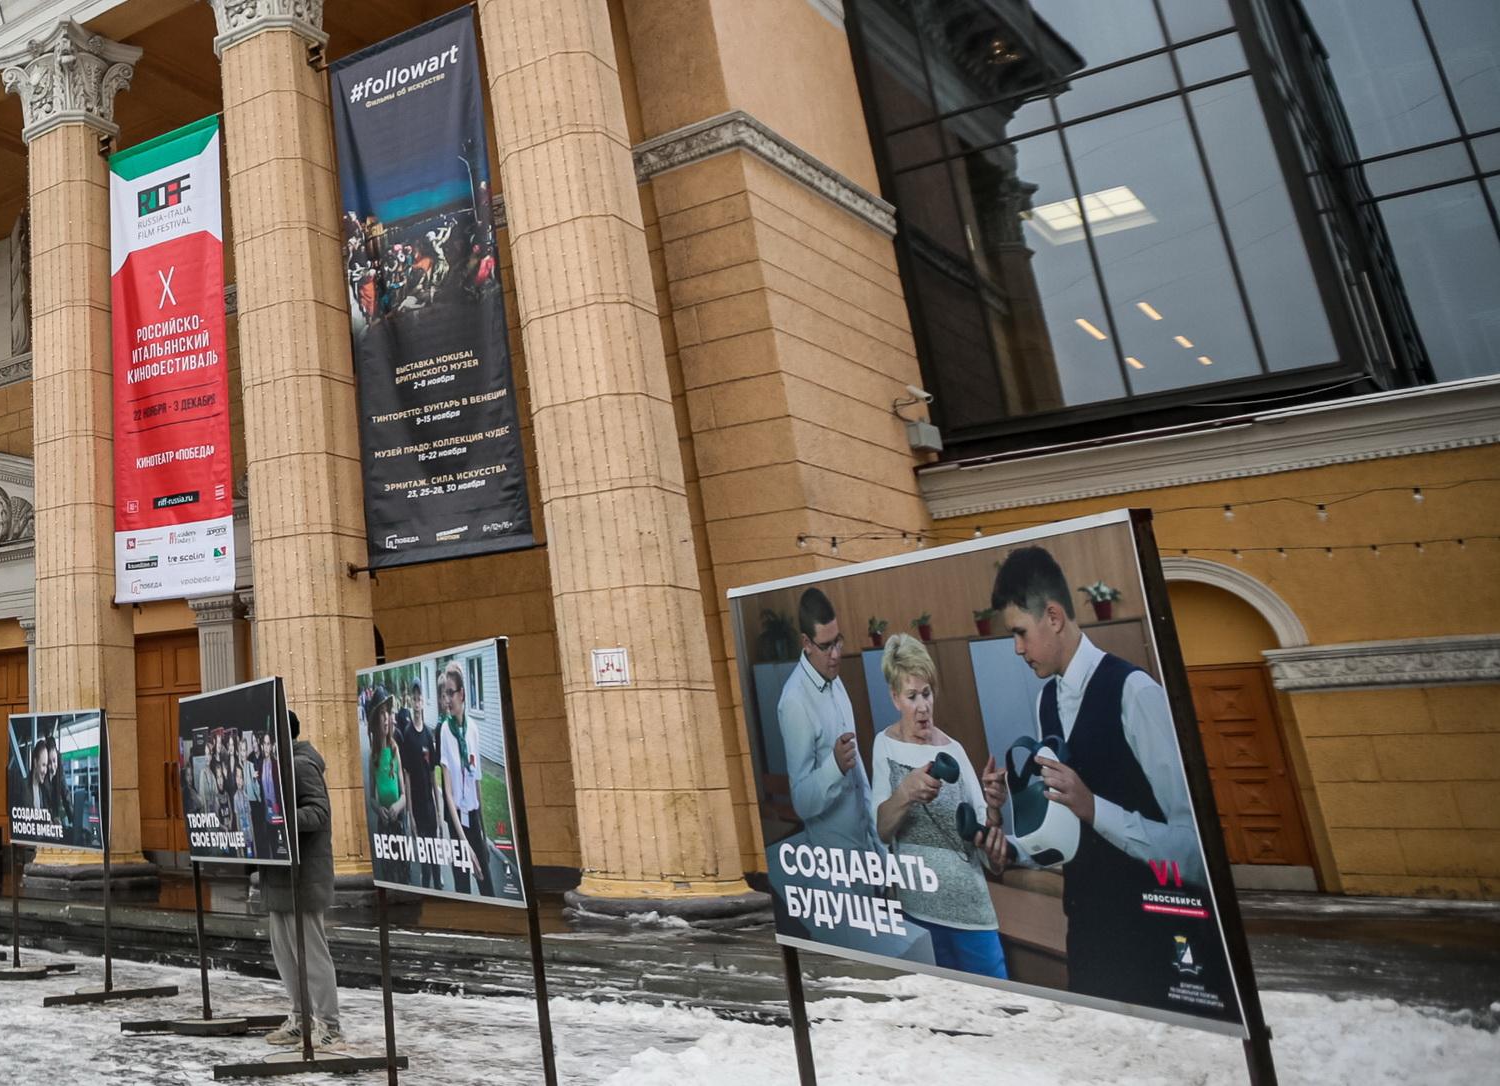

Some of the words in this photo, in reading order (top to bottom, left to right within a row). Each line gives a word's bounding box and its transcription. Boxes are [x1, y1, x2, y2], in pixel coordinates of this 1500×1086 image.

[349, 44, 459, 104] #followart
[365, 91, 396, 109] Фильмы
[396, 87, 407, 98] об
[407, 72, 445, 92] искусстве
[137, 205, 192, 229] RUSSIA-ITALIA
[137, 225, 156, 240] FILM
[156, 217, 192, 234] FESTIVAL
[136, 314, 204, 343] РОССИЙСКО-
[131, 331, 210, 364] ИТАЛЬЯНСКИЙ
[126, 351, 219, 385] КИНОФЕСТИВАЛЬ
[395, 366, 448, 385] БРИТАНСКОГО
[450, 358, 479, 374] МУЗЕЯ
[396, 358, 435, 376] ВЫСТАВКА
[436, 349, 474, 364] HOKUSAI
[426, 373, 455, 387] ноября
[173, 399, 180, 413] 3
[180, 393, 217, 413] ДЕКАБРЯ
[372, 408, 422, 425] ТИНТОРЕТТО:
[423, 400, 460, 413] БУНТАРЬ
[462, 397, 469, 406] В
[470, 388, 508, 404] ВЕНЕЦИИ
[431, 409, 461, 424] ноября
[374, 446, 402, 460] МУЗЕЙ
[403, 441, 432, 457] ПРАДО:
[432, 432, 484, 450] КОЛЛЕКЦИЯ
[485, 425, 510, 441] ЧУДЕС
[438, 446, 467, 460] ноября
[136, 451, 176, 470] КИНОТЕАТР
[175, 444, 215, 462] «ПОБЕДА»
[384, 478, 429, 493] ЭРМИТАЖ.
[431, 473, 455, 486] СИЛА
[456, 463, 507, 481] ИСКУССТВА
[446, 483, 457, 493] 30
[457, 479, 486, 492] ноября
[157, 493, 194, 508] riff-russia.ru
[394, 535, 420, 545] ПОБЕДА
[11, 805, 52, 823] СОЗДАВАТЬ
[186, 812, 220, 829] ТВОРИТЬ
[12, 821, 36, 836] НОВОЕ
[36, 823, 64, 839] ВМЕСТЕ
[190, 831, 211, 848] СВОЕ
[211, 831, 246, 850] БУДУЩЕЕ
[373, 832, 416, 862] ВЕСТИ
[416, 834, 475, 875] ВПЕРЕД
[779, 842, 939, 893] СОЗДАВАТЬ
[784, 885, 908, 937] БУДУЩЕЕ
[1141, 893, 1203, 908] НОВОСИБИРСК
